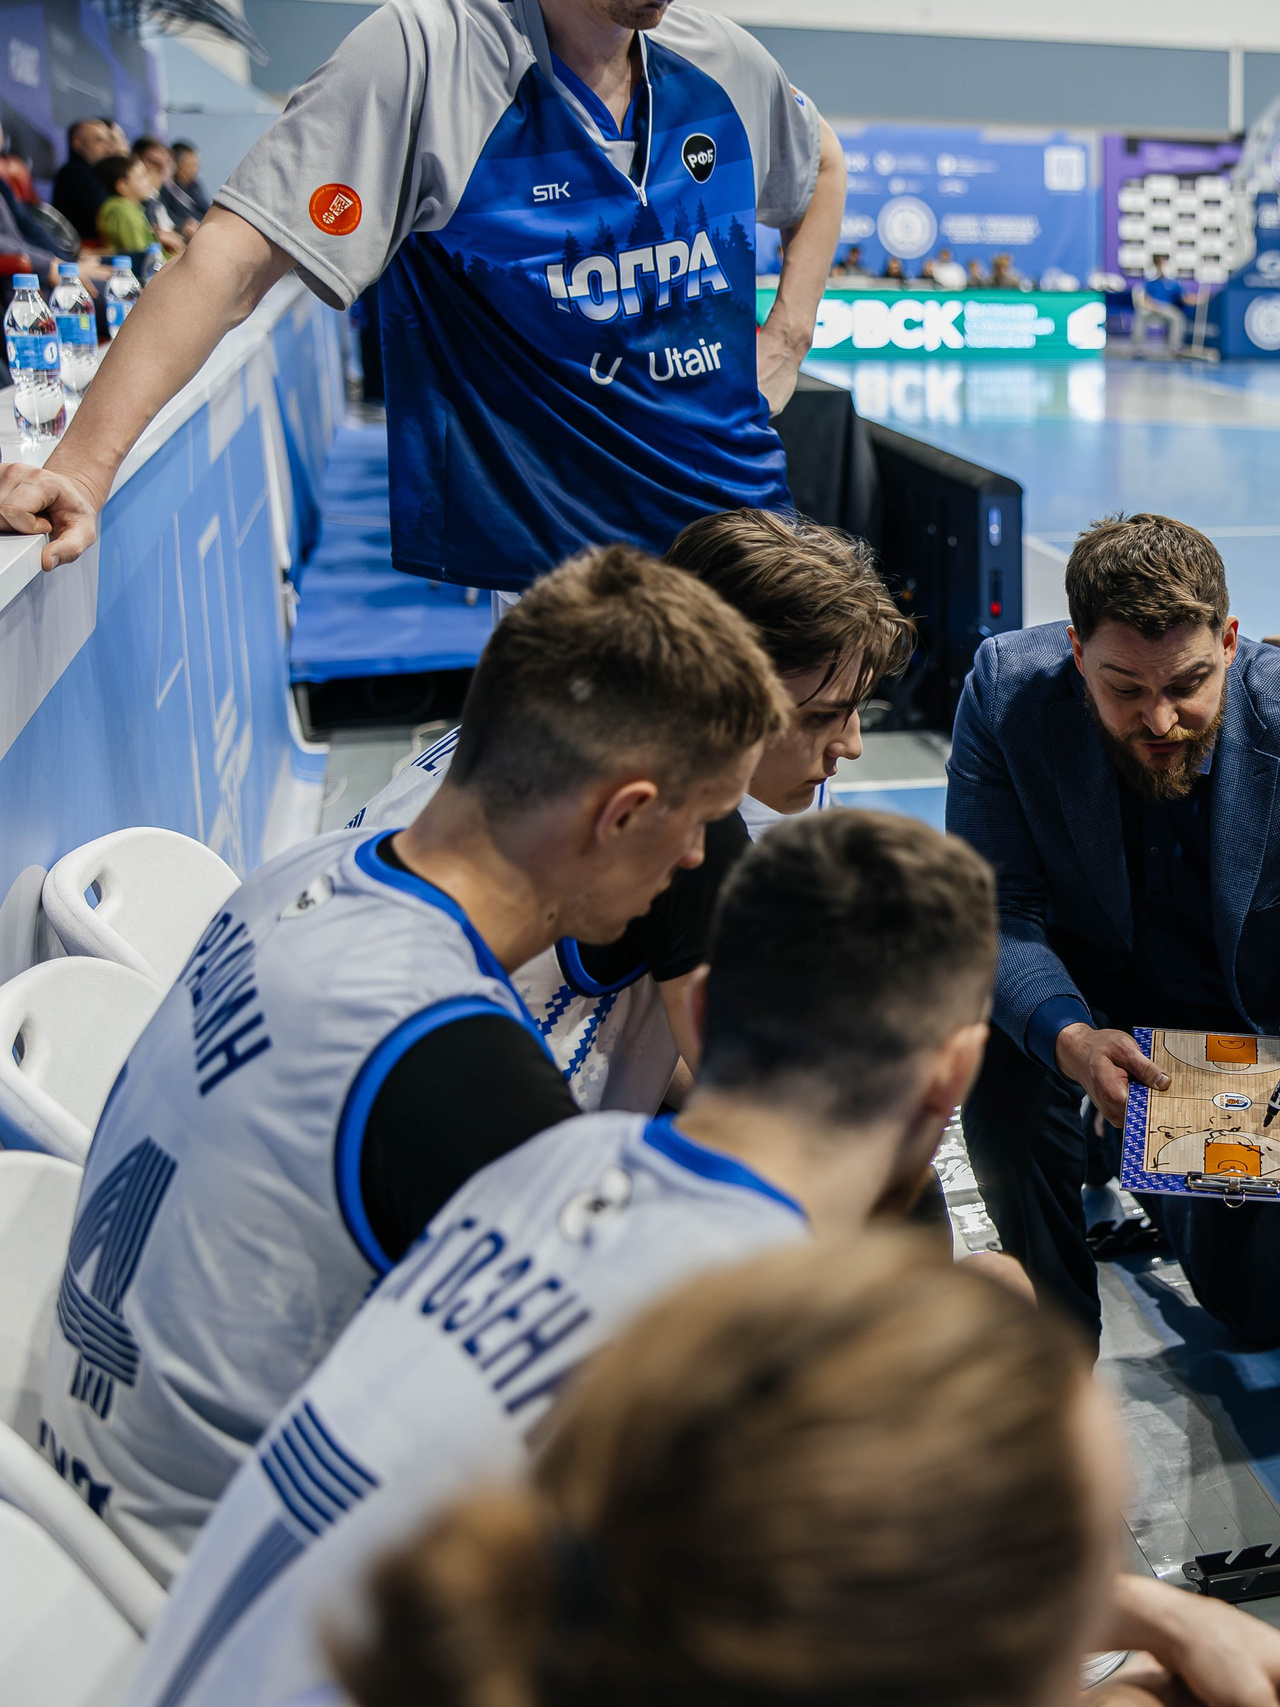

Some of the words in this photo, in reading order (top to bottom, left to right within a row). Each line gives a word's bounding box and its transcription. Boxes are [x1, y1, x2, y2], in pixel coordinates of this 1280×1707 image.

[687, 149, 714, 168] РФБ
[533, 181, 571, 202] STK
[546, 229, 730, 322] ЮГРА
[649, 338, 722, 381] Utair
